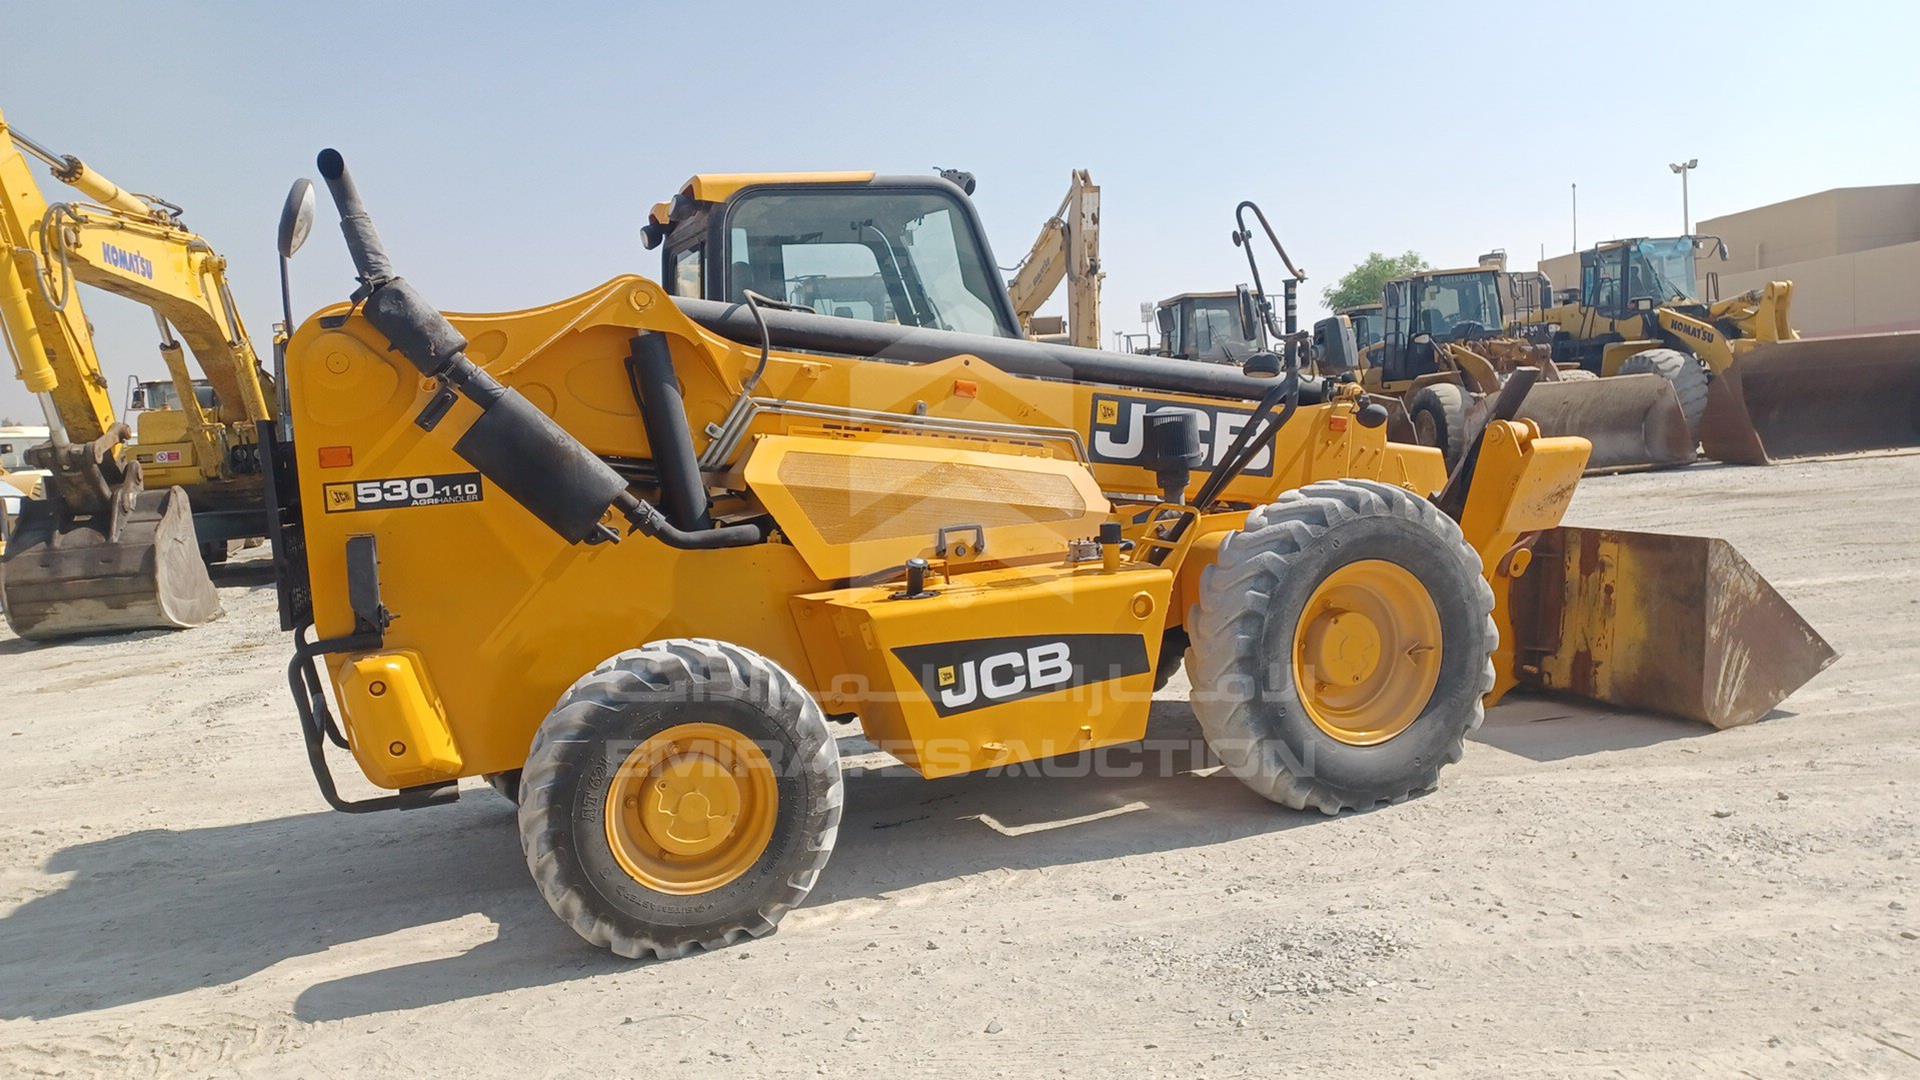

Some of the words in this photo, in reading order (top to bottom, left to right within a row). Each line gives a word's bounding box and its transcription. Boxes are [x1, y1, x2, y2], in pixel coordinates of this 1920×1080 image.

[102, 241, 153, 280] KOMATSU
[1671, 319, 1714, 343] KOMATSU
[941, 642, 1073, 708] JCB
